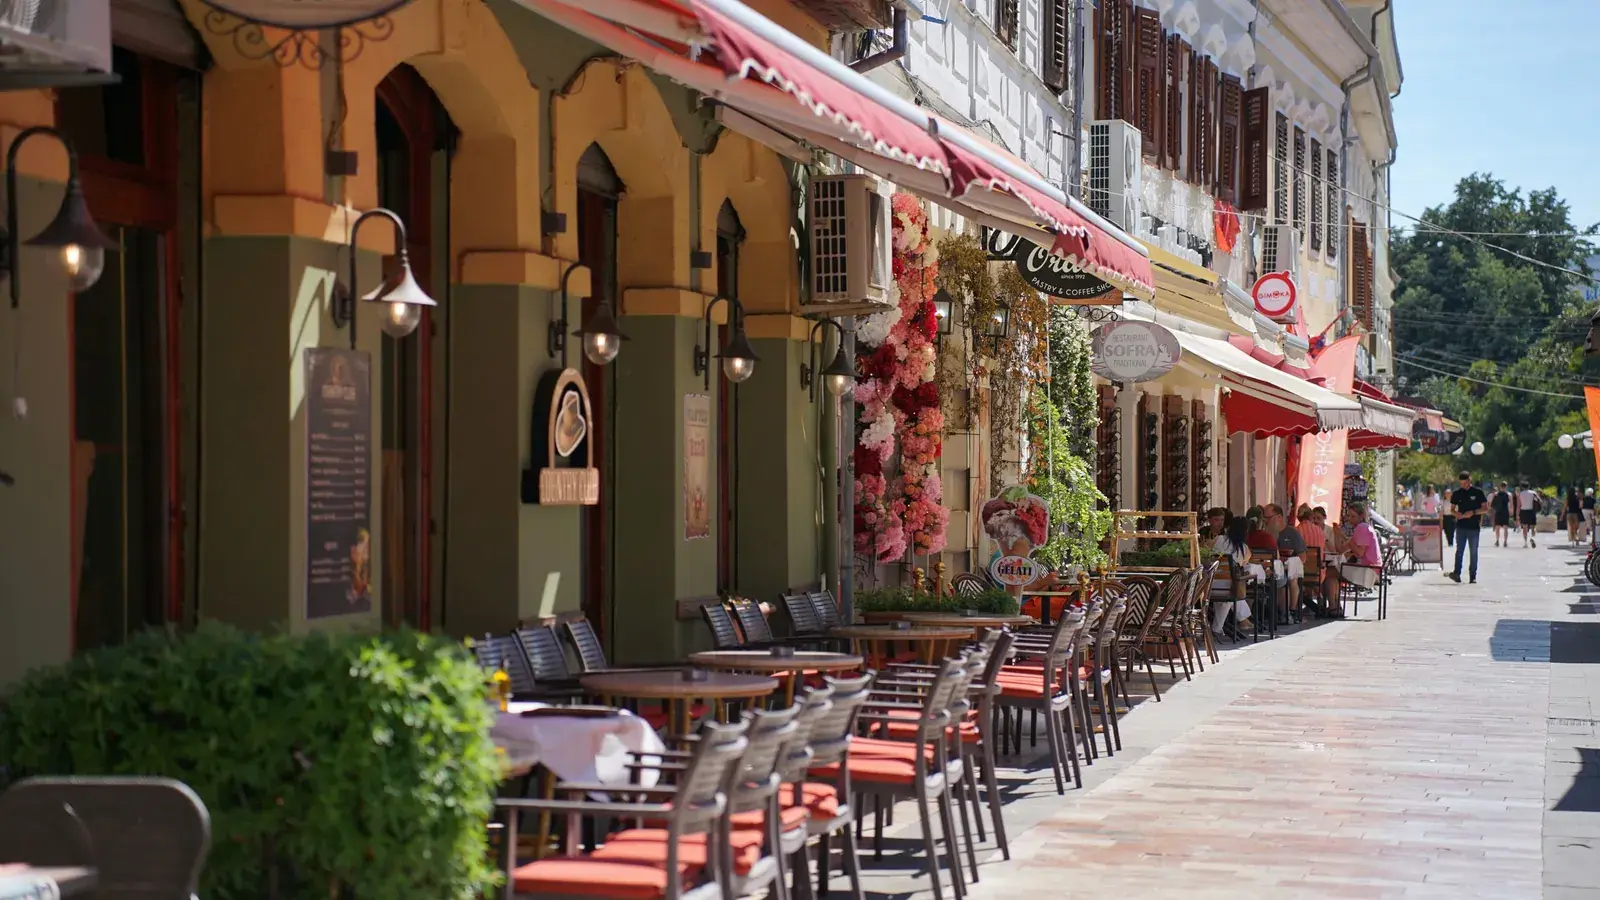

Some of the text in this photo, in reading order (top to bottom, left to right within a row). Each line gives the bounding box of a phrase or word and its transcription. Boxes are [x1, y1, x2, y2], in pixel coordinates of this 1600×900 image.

[1031, 276, 1112, 296] PASTRY & COFFEE SHO
[1258, 291, 1290, 299] GIMOKA
[1112, 333, 1149, 342] RESTAURANT
[1104, 344, 1156, 357] SOFRA
[997, 565, 1032, 576] GELATI
